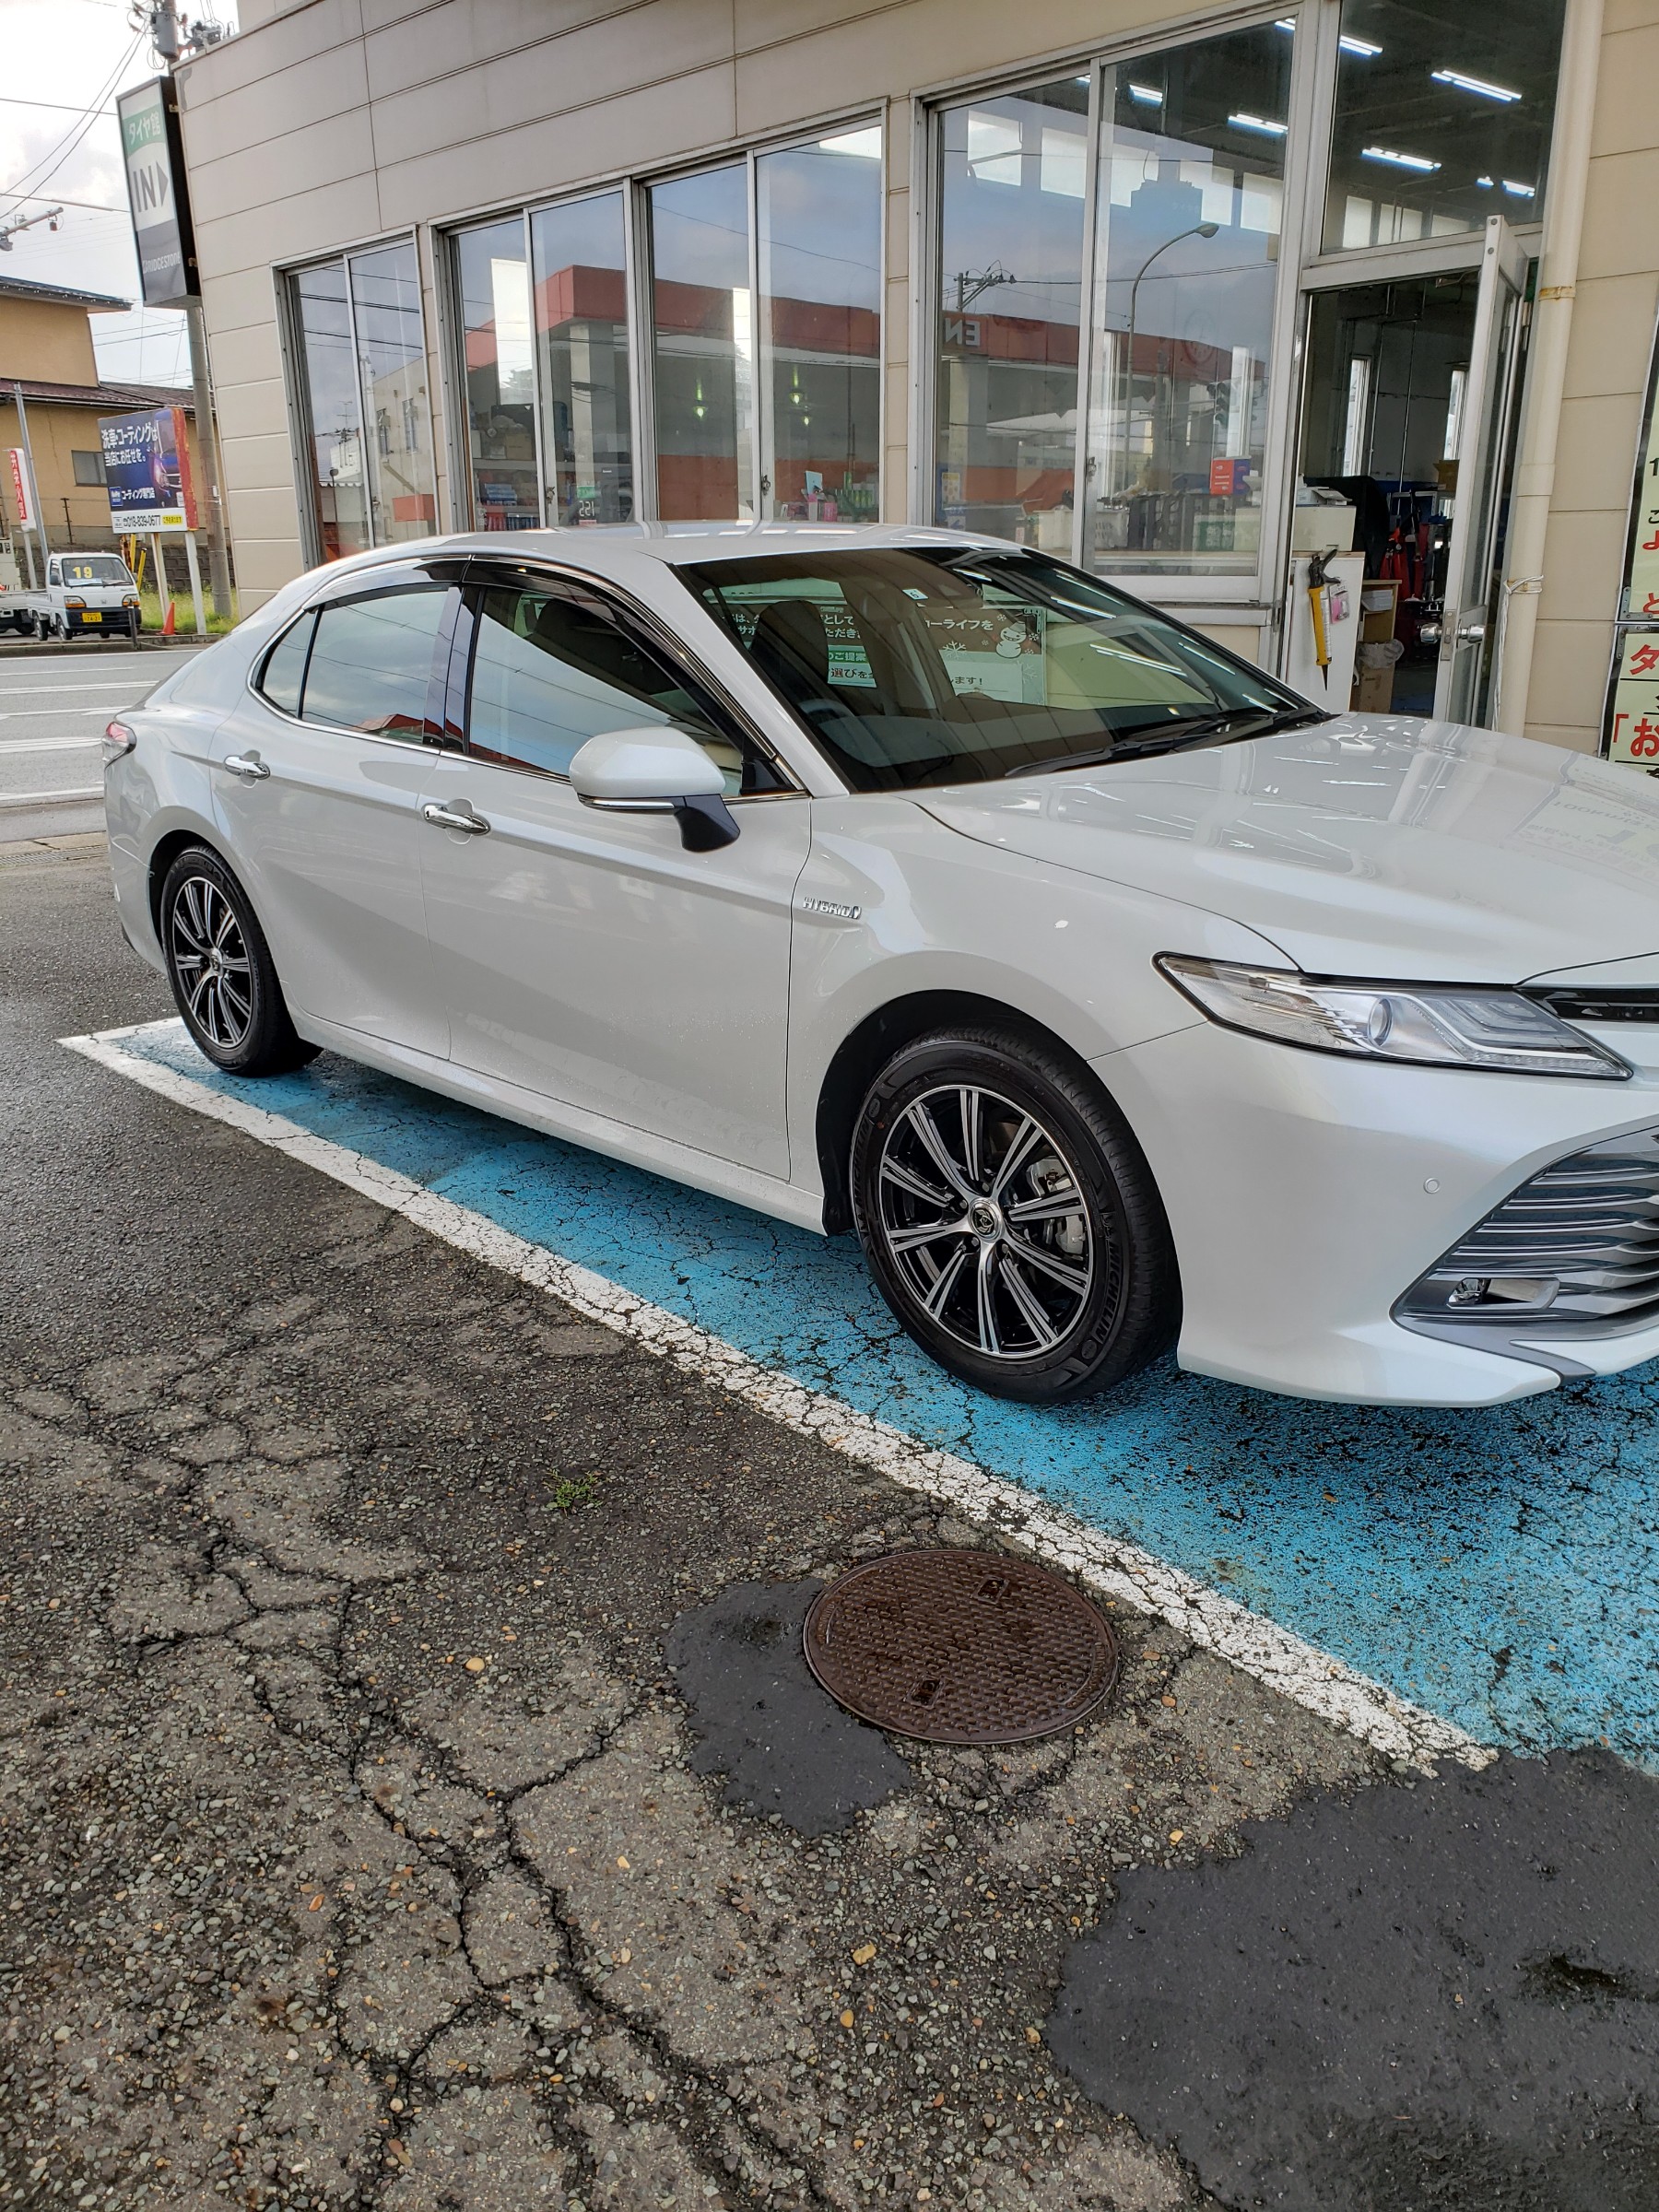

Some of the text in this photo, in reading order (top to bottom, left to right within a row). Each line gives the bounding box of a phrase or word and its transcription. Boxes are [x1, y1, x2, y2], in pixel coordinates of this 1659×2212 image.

[128, 112, 161, 146] タイヤ館
[133, 165, 157, 213] IN
[142, 251, 182, 275] BRIDGESTONE
[73, 566, 93, 579] 19
[1095, 1241, 1121, 1343] MICHELIN
